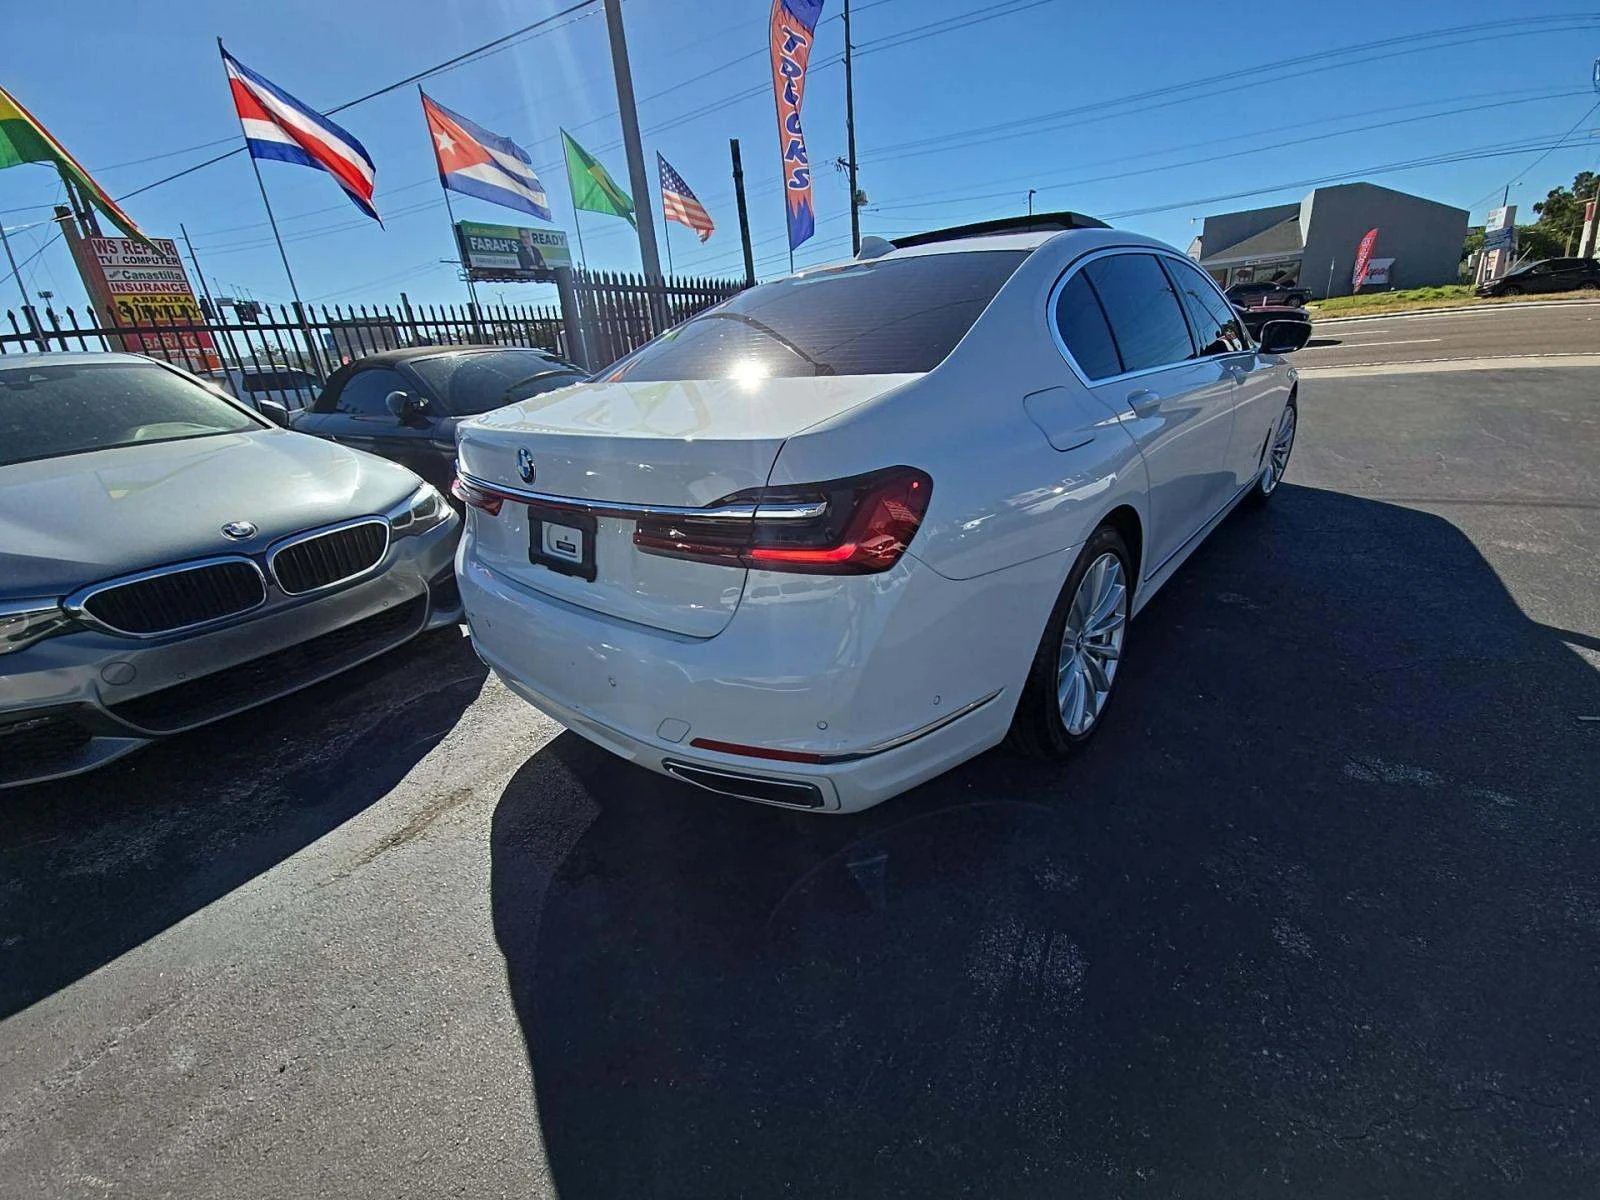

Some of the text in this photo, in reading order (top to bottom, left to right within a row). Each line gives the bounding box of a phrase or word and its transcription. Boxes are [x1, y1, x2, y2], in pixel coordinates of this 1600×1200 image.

[470, 237, 519, 253] FARAH'S
[532, 232, 565, 246] READY
[120, 240, 176, 256] REPIR
[99, 256, 180, 266] TV COMPUTER
[122, 270, 182, 280] Canastilla
[110, 282, 189, 292] INSURANCE
[133, 304, 200, 320] JWLY
